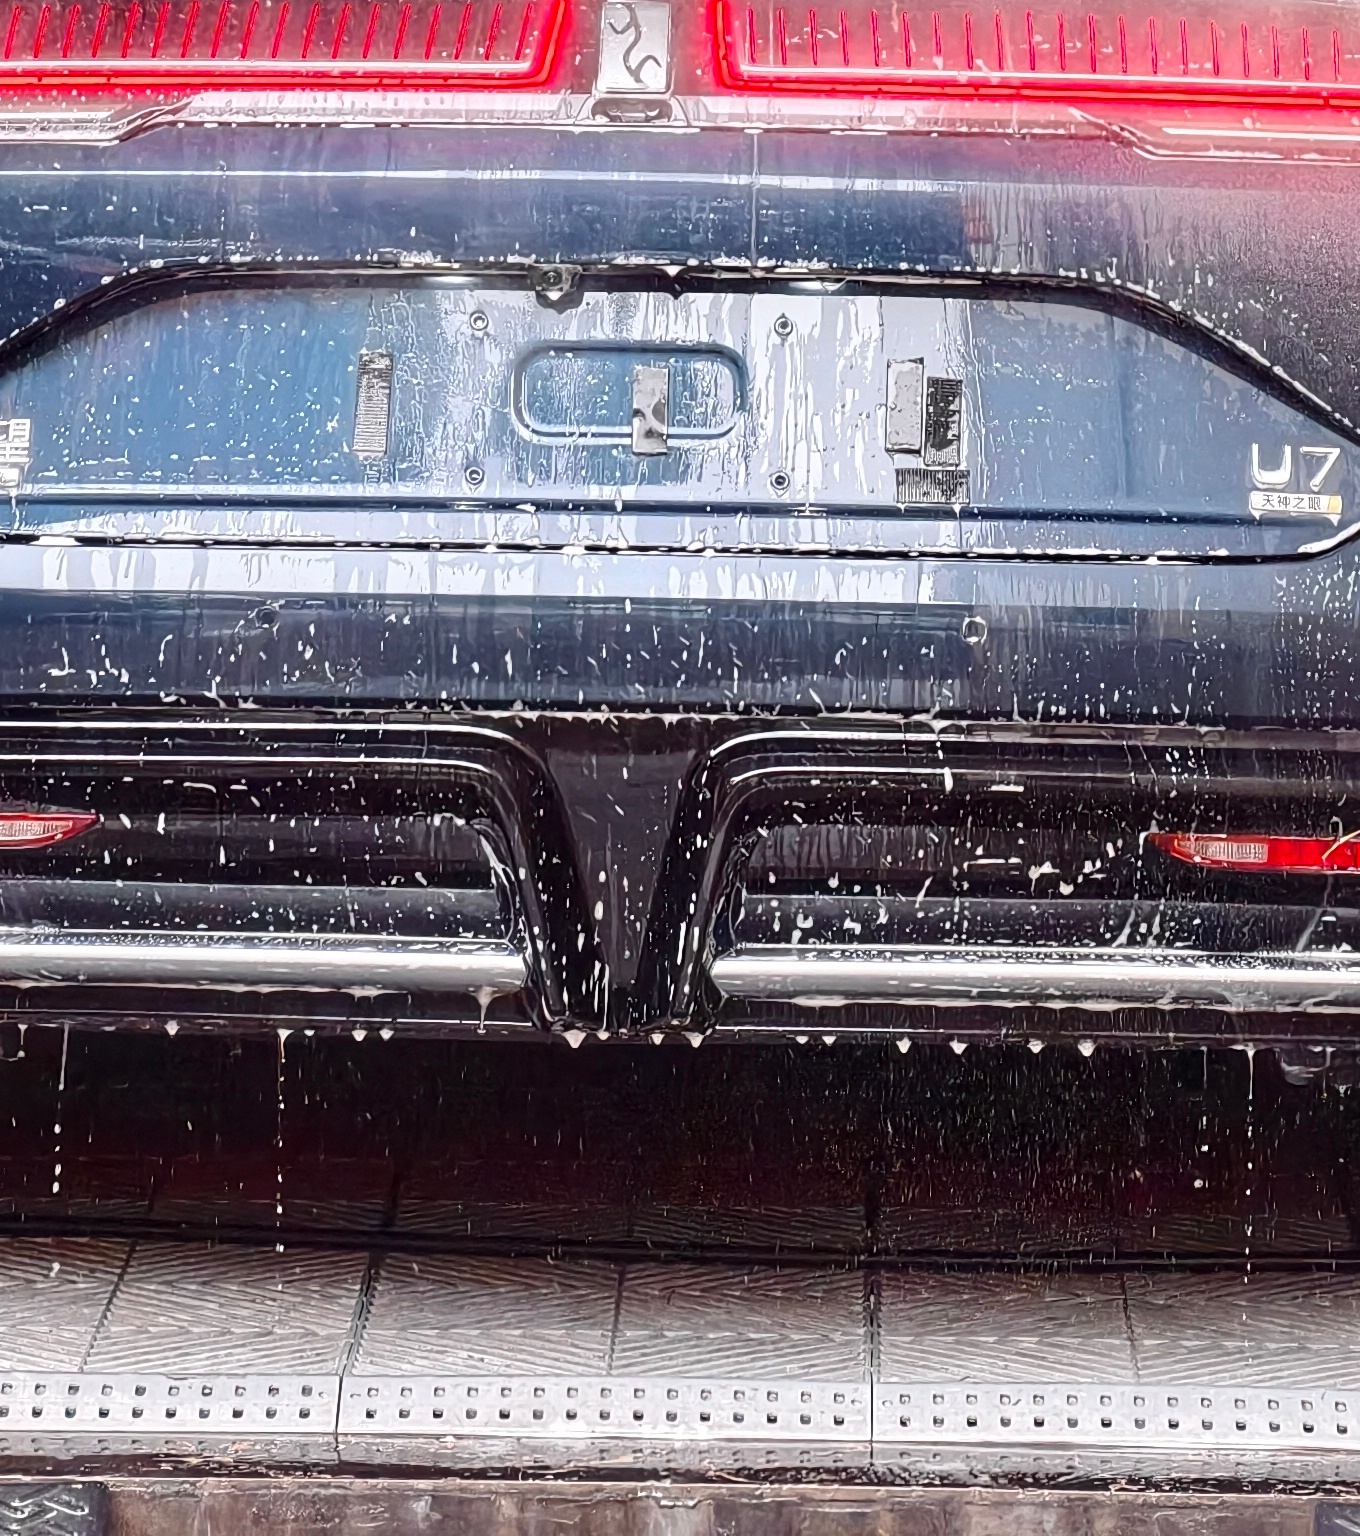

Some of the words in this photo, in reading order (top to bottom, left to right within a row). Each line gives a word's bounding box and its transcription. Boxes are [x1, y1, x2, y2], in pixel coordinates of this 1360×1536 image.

[1251, 443, 1342, 491] U7
[1261, 494, 1322, 511] 天神之眼
